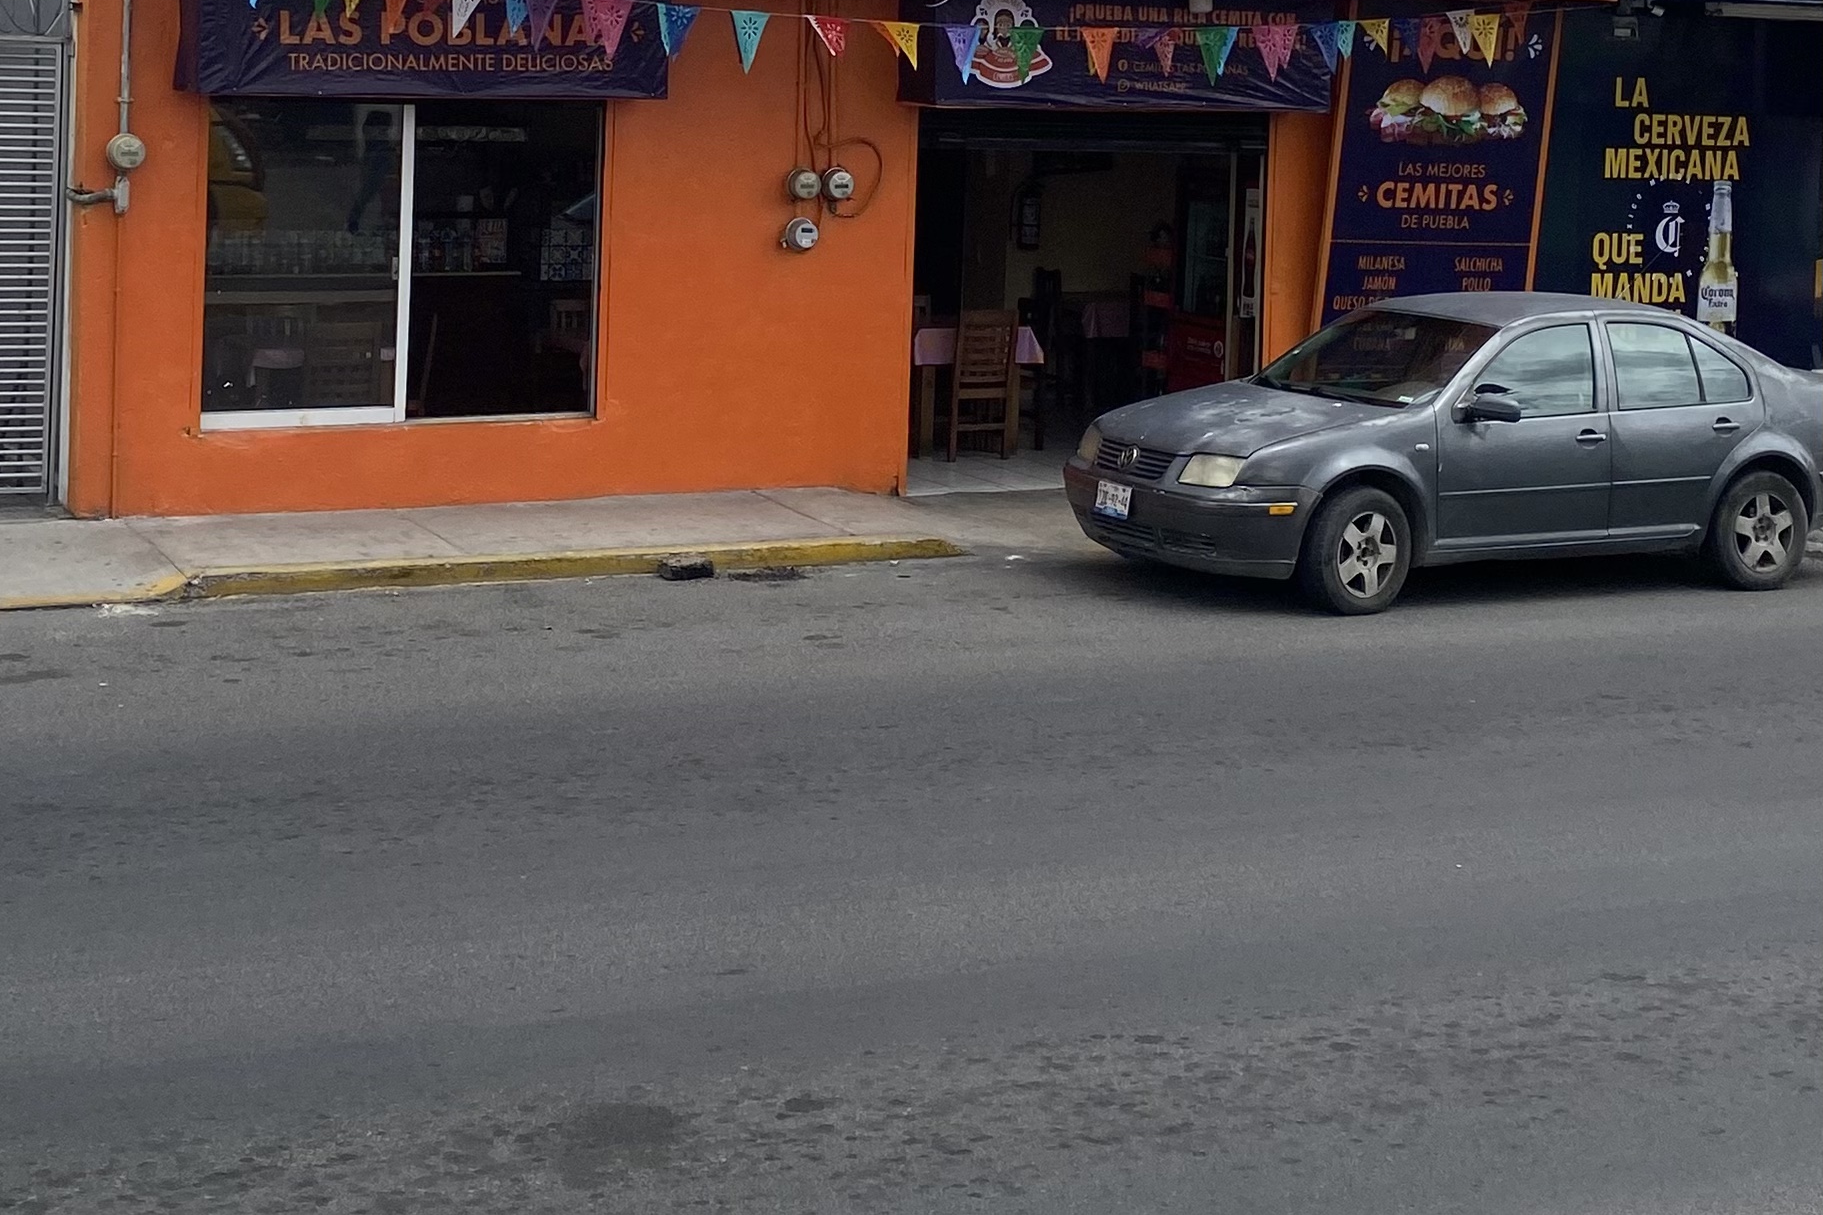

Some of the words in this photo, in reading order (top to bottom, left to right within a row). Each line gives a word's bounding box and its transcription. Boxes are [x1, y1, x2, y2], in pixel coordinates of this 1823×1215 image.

[1211, 10, 1262, 25] CEMITA
[279, 10, 363, 46] LAS
[380, 10, 622, 47] POBLANA
[288, 53, 495, 72] TRADICIONALMENTE
[502, 53, 614, 72] DELICIOSAS
[1614, 76, 1649, 108] LA
[1634, 113, 1750, 147] CERVEZA
[1398, 161, 1423, 177] LAS
[1427, 162, 1486, 179] MEJORES
[1604, 147, 1740, 181] MEXICANA
[1376, 181, 1498, 212] CEMITAS
[1401, 214, 1420, 229] DE
[1422, 215, 1470, 230] PUEBLA
[1592, 232, 1644, 270] QUE
[1357, 255, 1406, 271] MILANESA
[1454, 256, 1503, 272] SALCHICHA
[1362, 273, 1397, 290] JAMÓN
[1462, 277, 1492, 291] POLLO
[1591, 272, 1686, 304] MANDA
[1333, 295, 1366, 310] QUESO
